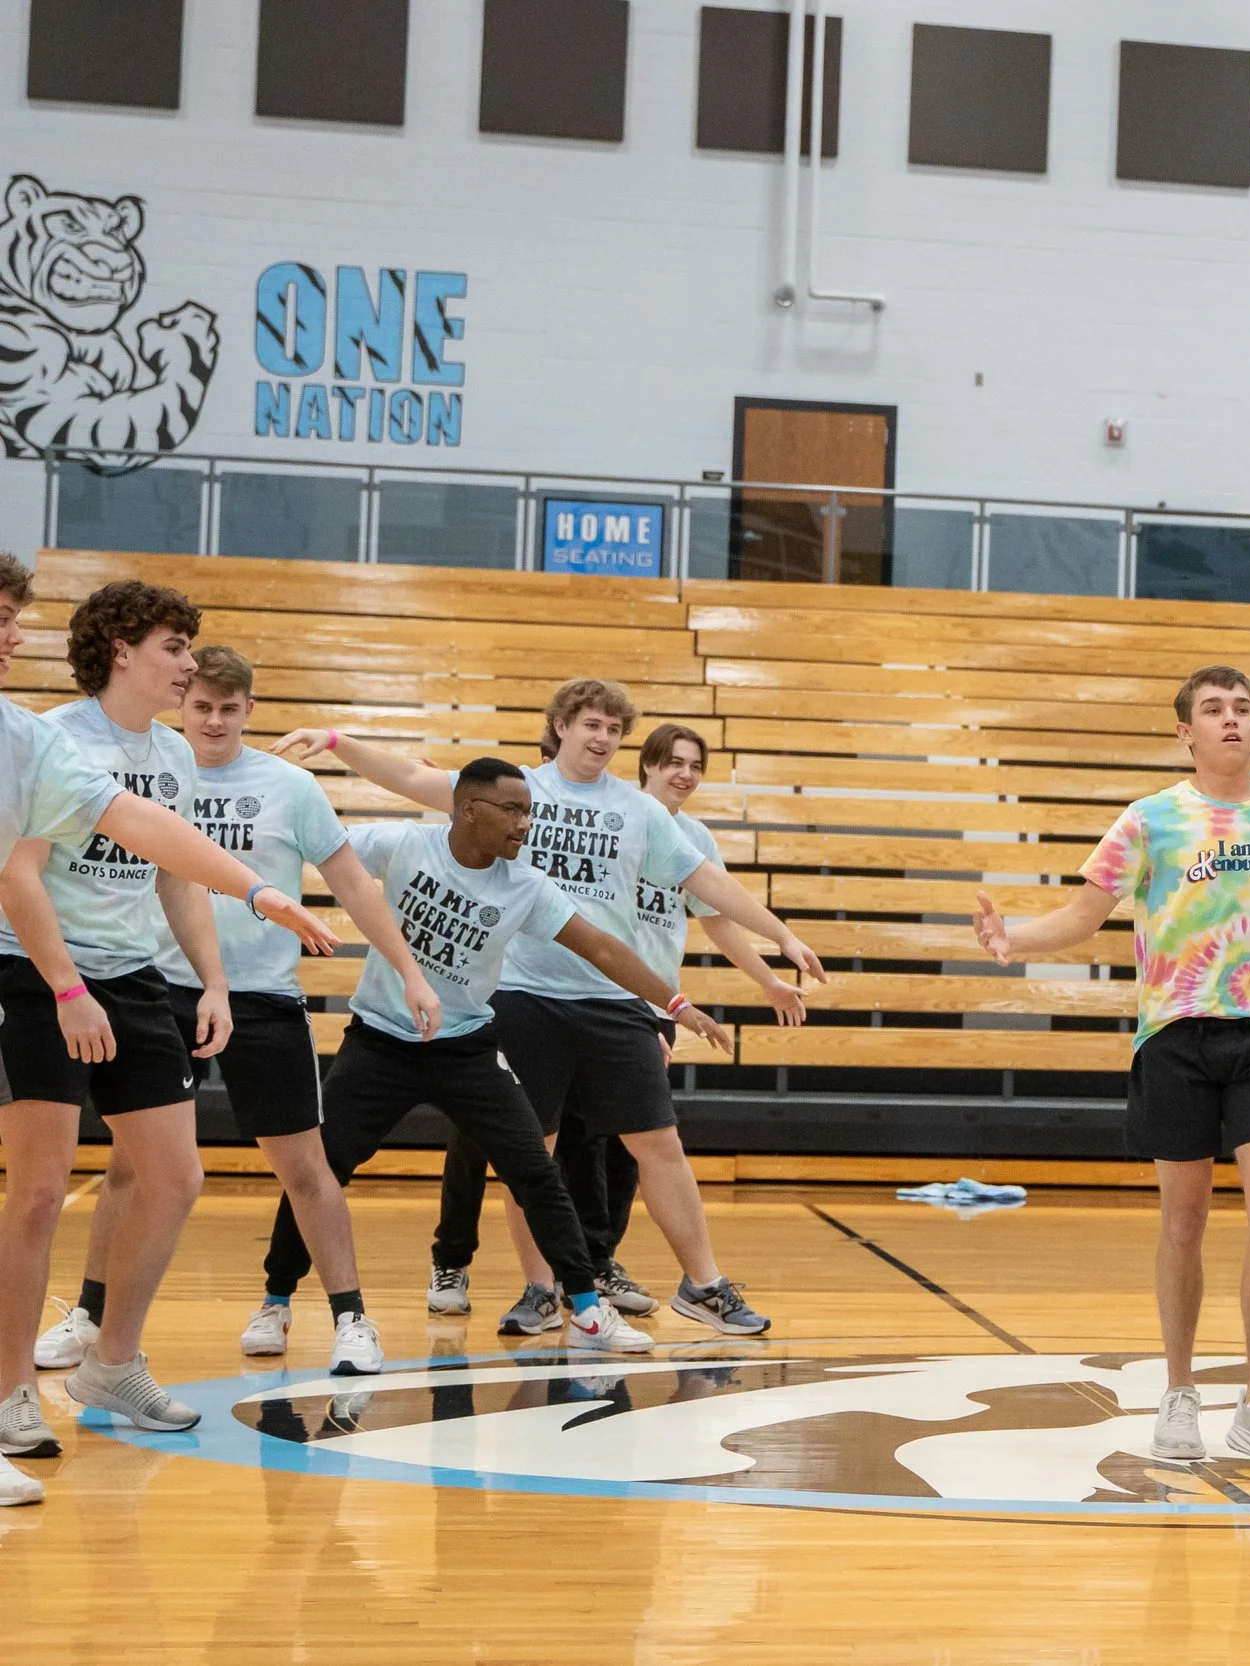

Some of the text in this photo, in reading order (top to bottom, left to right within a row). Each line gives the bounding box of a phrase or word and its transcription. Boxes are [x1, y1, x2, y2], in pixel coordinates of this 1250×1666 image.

[254, 260, 468, 387] ONE
[254, 380, 463, 447] NATION
[557, 511, 651, 545] HOME
[552, 546, 653, 568] SEATING
[193, 798, 232, 819] MY
[563, 807, 601, 828] MY
[1217, 840, 1226, 856] I
[69, 861, 148, 880] BOYS DANCE
[531, 850, 597, 883] ERA
[409, 870, 479, 918] IN MY
[555, 882, 615, 901] ANCE 2024
[398, 889, 490, 952] TIGERETTE
[401, 917, 455, 967] ERA
[446, 972, 470, 986] 2024
